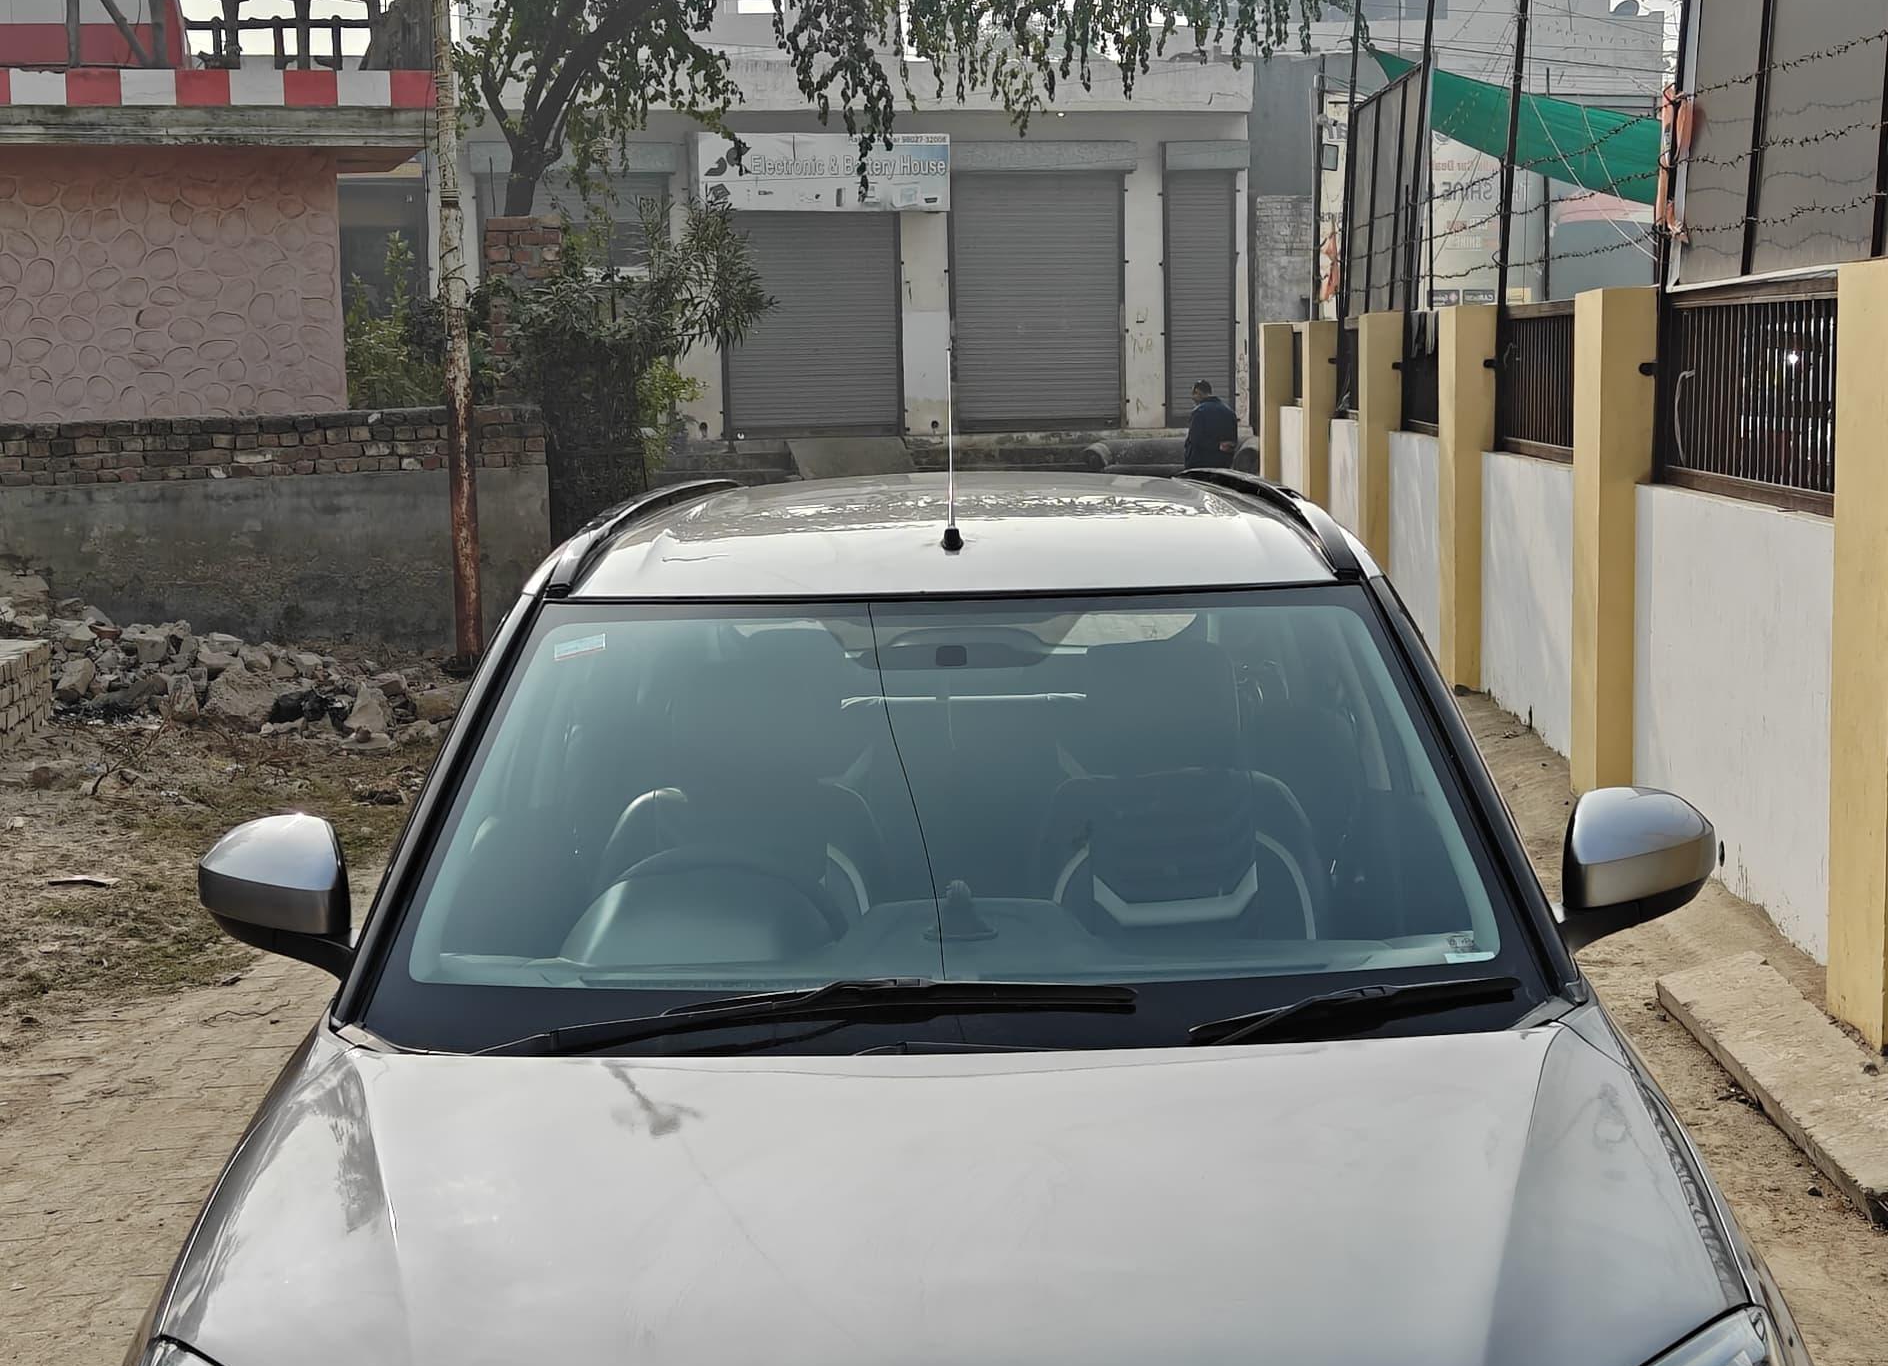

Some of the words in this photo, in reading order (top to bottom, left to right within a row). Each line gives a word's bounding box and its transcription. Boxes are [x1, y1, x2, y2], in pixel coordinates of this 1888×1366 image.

[751, 154, 825, 175] Electronic
[828, 155, 839, 175] &
[843, 155, 896, 180] Btery
[900, 154, 946, 175] House
